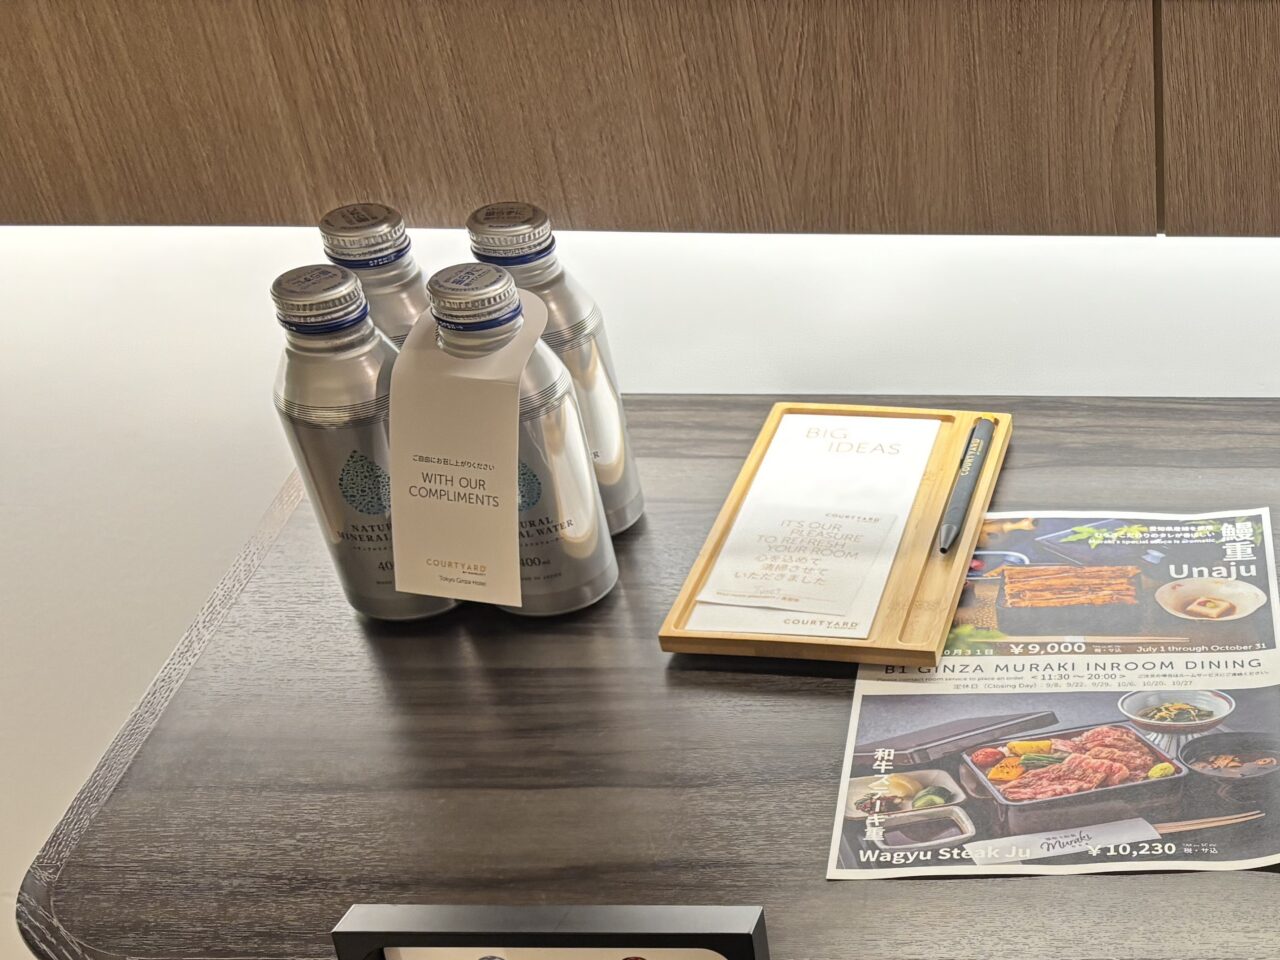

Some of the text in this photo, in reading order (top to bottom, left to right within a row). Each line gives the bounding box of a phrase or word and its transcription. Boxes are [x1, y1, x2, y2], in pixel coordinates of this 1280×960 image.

[805, 427, 848, 439] BIG
[960, 438, 981, 476] COURTYARD
[421, 472, 486, 491] WITH OUR
[408, 485, 500, 508] COMPLIMENTS
[520, 516, 553, 529] URAL
[825, 513, 880, 523] COURTYARD
[537, 519, 574, 536] WATER
[808, 521, 843, 532] OUR
[758, 534, 846, 549] TO REFRESH
[790, 529, 864, 543] PLEASURE
[1220, 521, 1257, 561] 鰻重
[767, 544, 860, 560] YOUR ROOM
[426, 558, 486, 573] COURTYARD
[1169, 562, 1257, 580] Unaju
[439, 575, 455, 584] Tokyo
[784, 618, 859, 628] COURTYARD
[1167, 645, 1207, 653] through
[1210, 643, 1253, 651] October
[885, 658, 1262, 674] B1 GINZA MURAKI INROOM DINING
[1040, 830, 1092, 852] Muraki
[859, 846, 1031, 864] Wagyu Steak Ju
